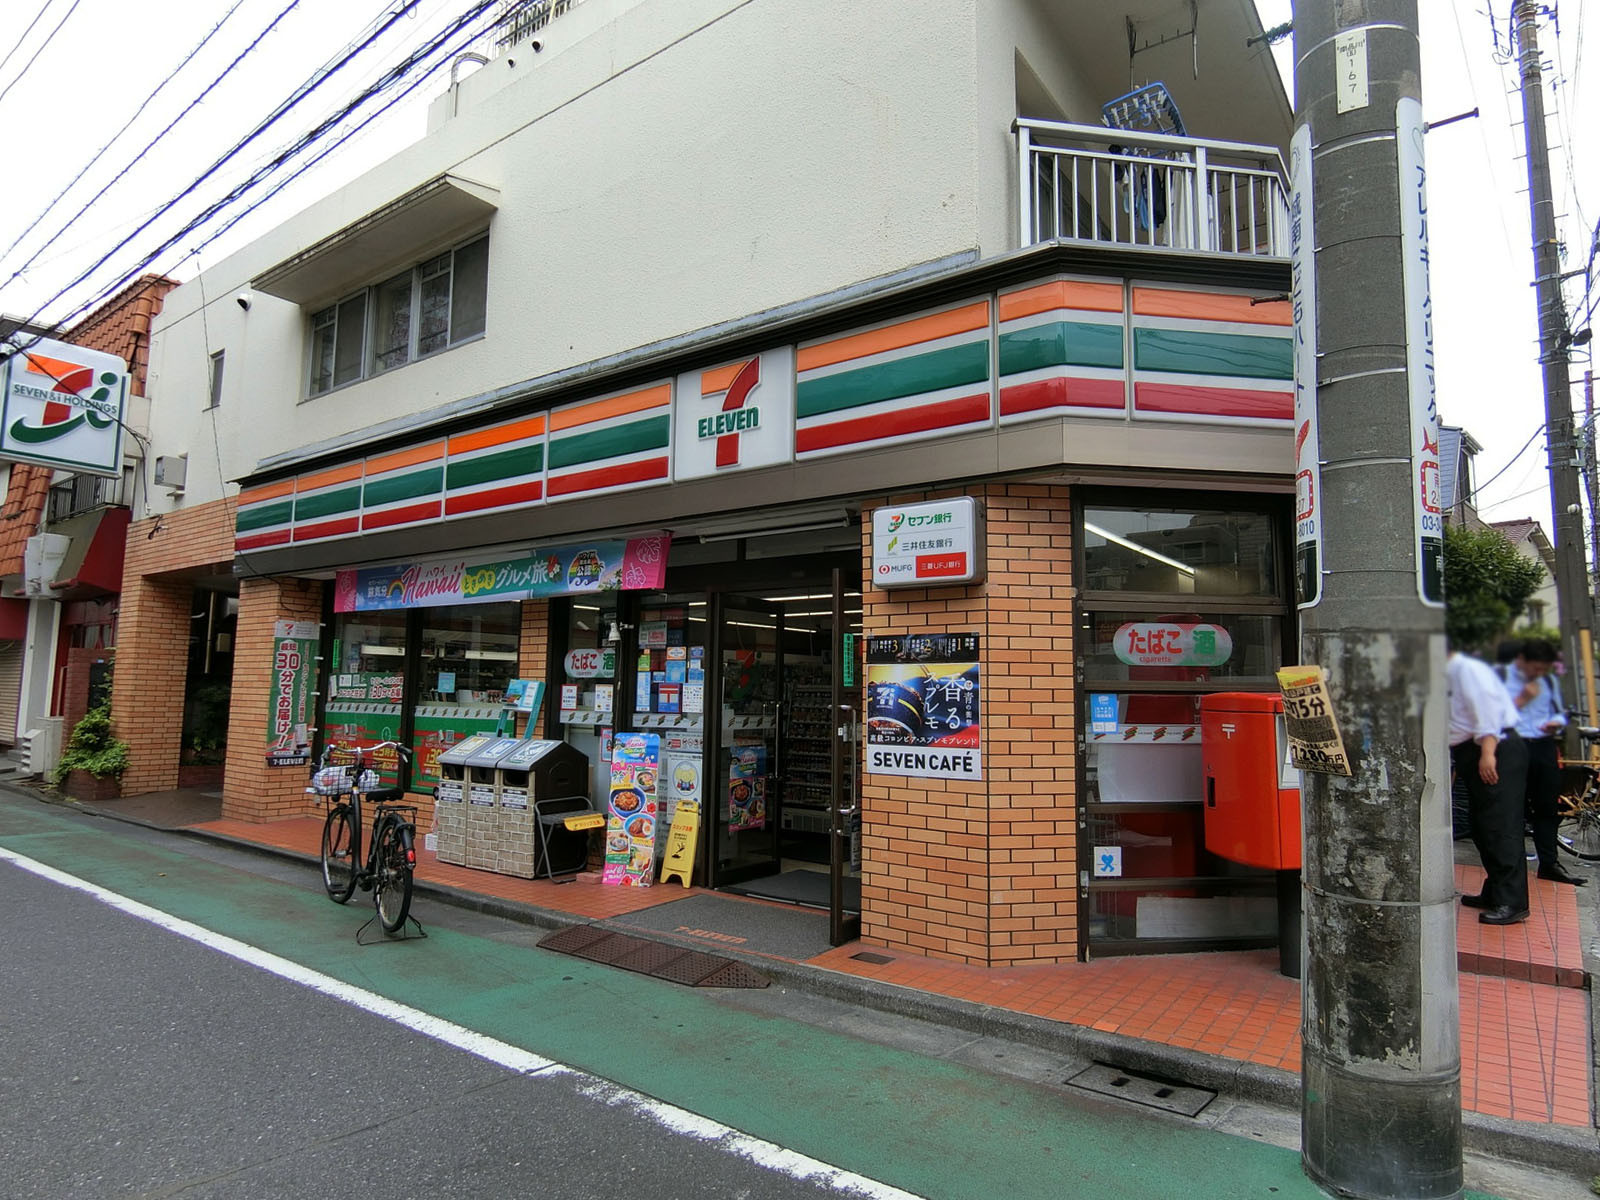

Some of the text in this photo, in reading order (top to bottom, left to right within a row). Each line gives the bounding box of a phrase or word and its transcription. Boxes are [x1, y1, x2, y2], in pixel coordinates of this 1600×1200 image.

[698, 407, 760, 438] ELEVEN
[908, 512, 953, 527] セブン銀行
[902, 537, 953, 552] 三井住友銀行
[890, 564, 913, 573] MUFG
[402, 562, 465, 604] Hawaii
[1128, 628, 1216, 655] たばこ 酒
[571, 653, 616, 670] たばこ 酒
[923, 671, 941, 729] スプレモ
[938, 672, 966, 730] 香る
[873, 751, 973, 772] SEVEN CAFÉ
